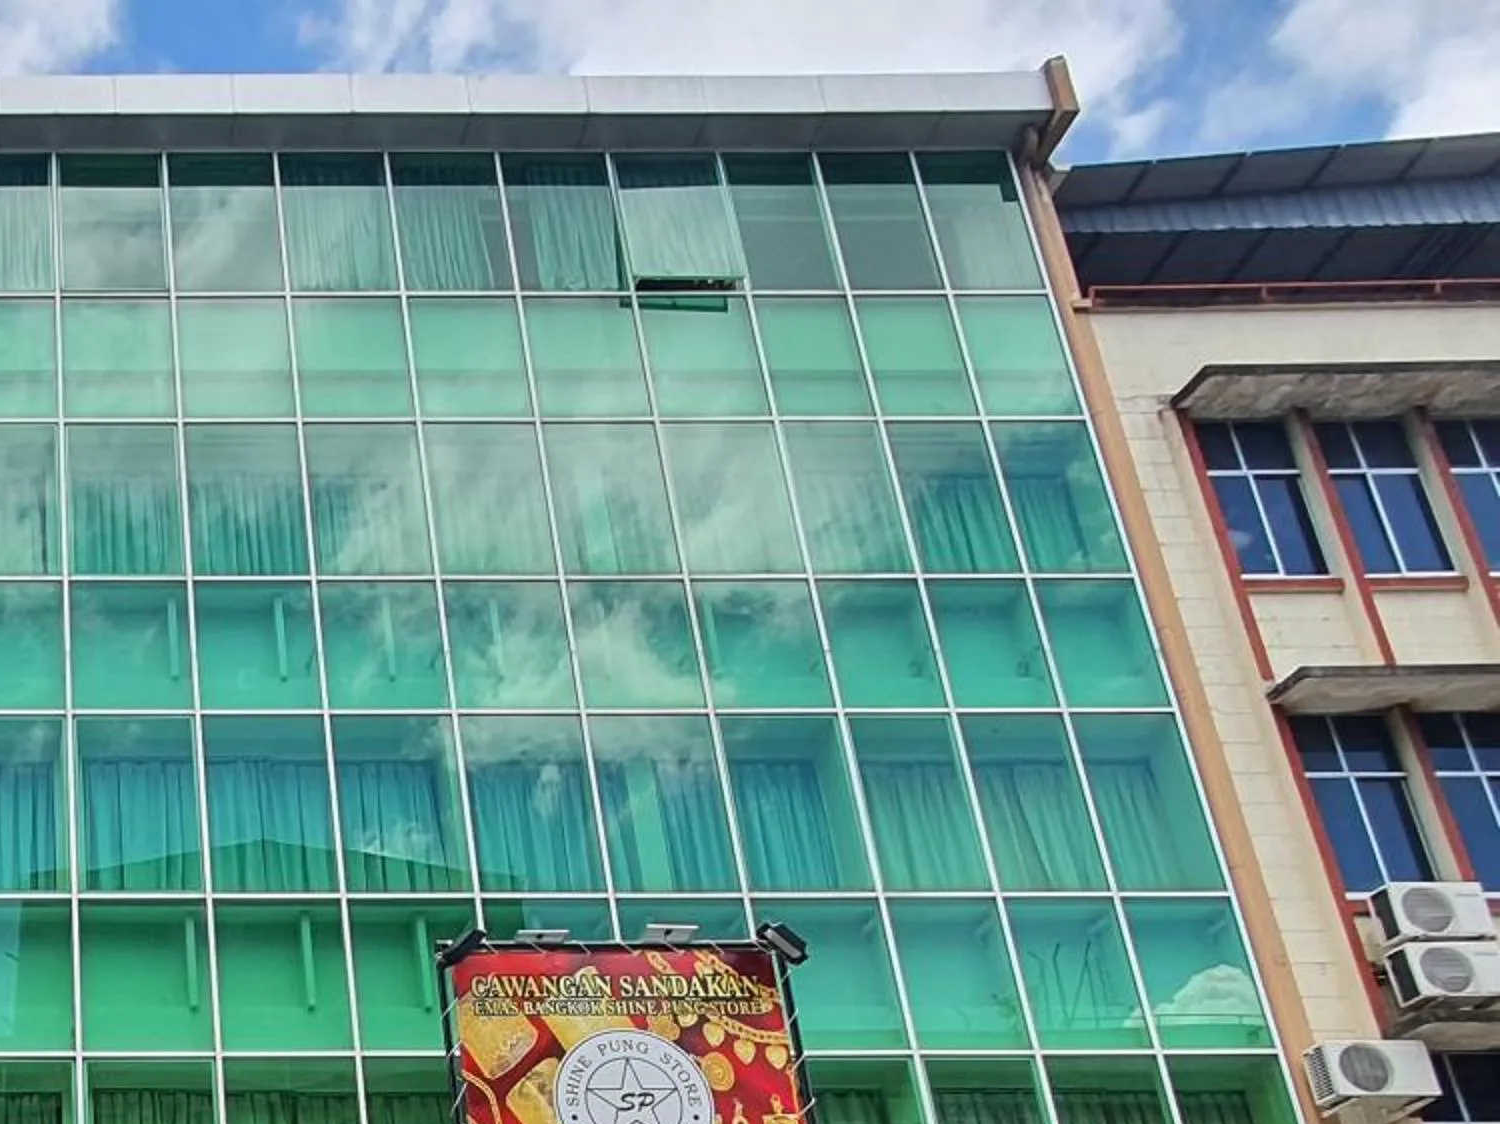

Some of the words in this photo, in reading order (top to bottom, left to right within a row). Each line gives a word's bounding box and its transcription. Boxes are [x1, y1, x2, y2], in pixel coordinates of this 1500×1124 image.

[471, 975, 612, 998] CAWANGAN
[619, 975, 760, 998] SANDAKAN
[474, 1001, 519, 1016] EMAS
[523, 1001, 604, 1016] BANGKOK
[606, 1001, 659, 1016] SHINE
[662, 1001, 707, 1016] PUNG
[709, 1001, 763, 1016] STORE
[566, 1055, 593, 1107] SHINE
[597, 1039, 649, 1057] PUNG
[659, 1052, 702, 1107] STORE
[617, 1092, 655, 1112] SP
